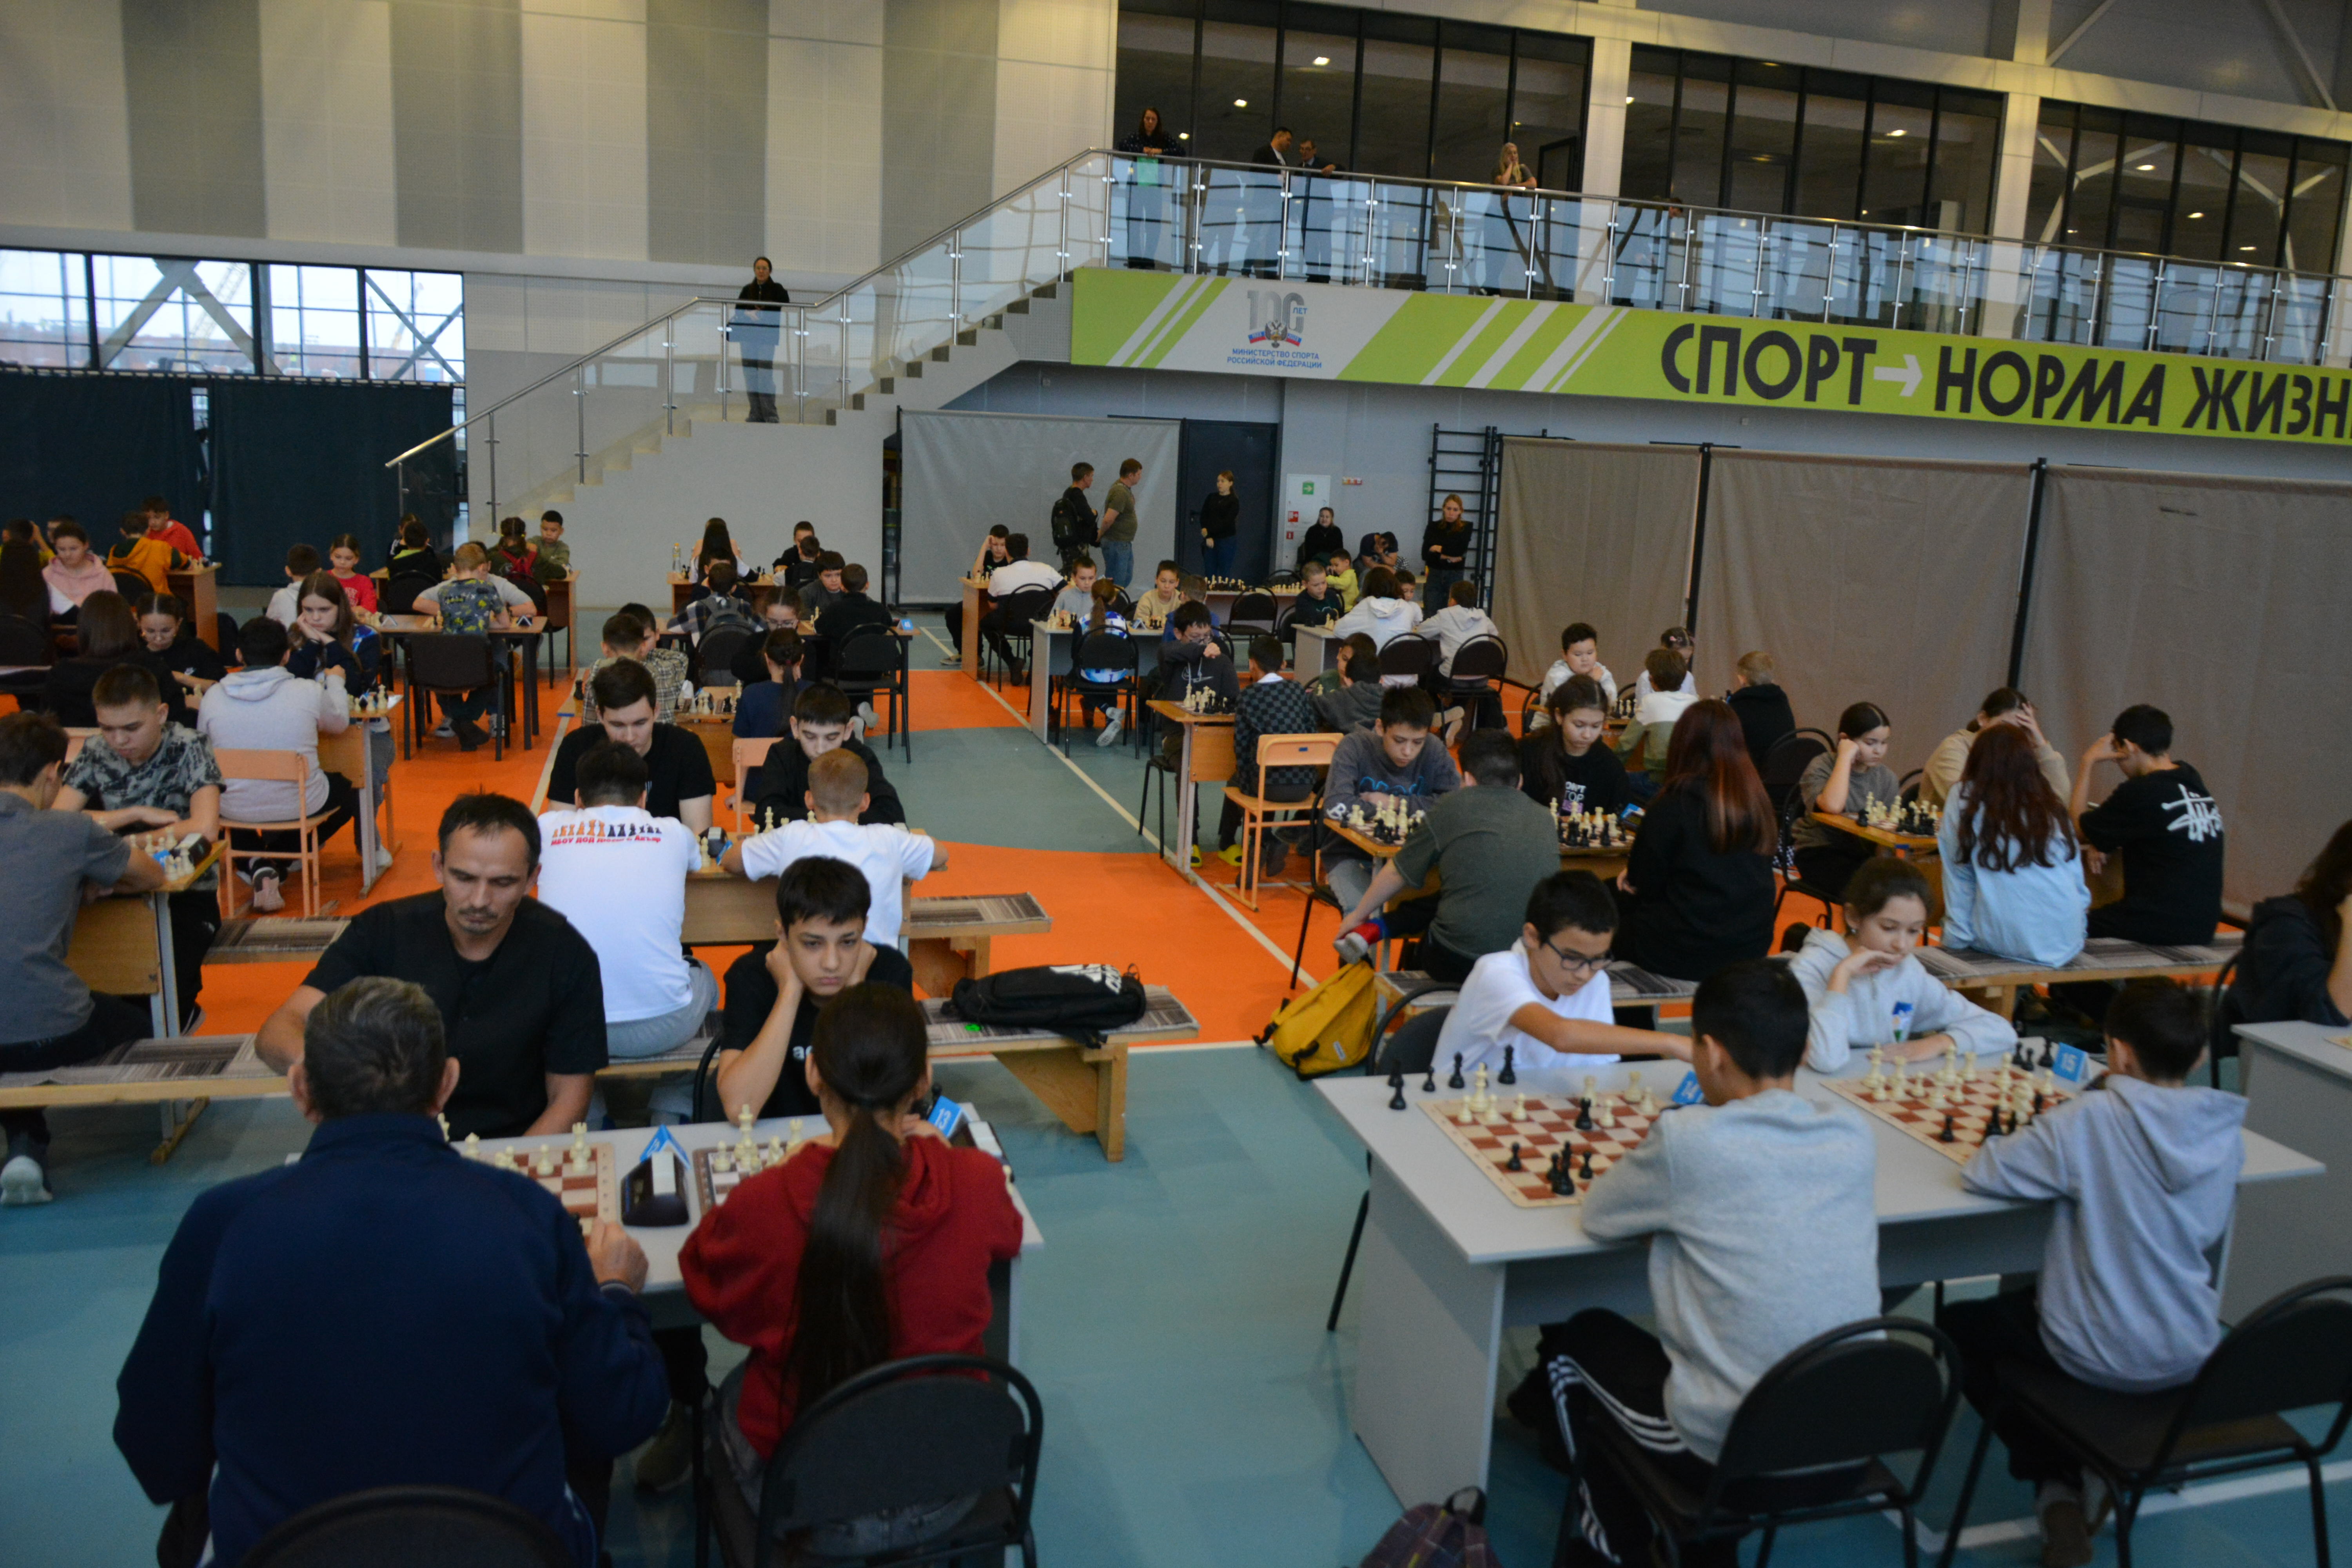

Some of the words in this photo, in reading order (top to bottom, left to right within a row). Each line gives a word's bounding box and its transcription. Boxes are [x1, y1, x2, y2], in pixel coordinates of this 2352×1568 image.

[1227, 356, 1275, 365] РОССИЙСКОЙ
[1277, 359, 1322, 368] ФЕДЕРАЦИИ
[1232, 348, 1290, 358] МИНИСТЕРСТВО
[1661, 323, 1878, 405] СПОРТ
[1934, 345, 2167, 426] НОРМА
[2181, 366, 2352, 439] ЖИЗН
[1565, 790, 1584, 802] TOP
[2061, 1053, 2077, 1072] 15
[1681, 1081, 1699, 1100] 14
[935, 1108, 952, 1130] 13
